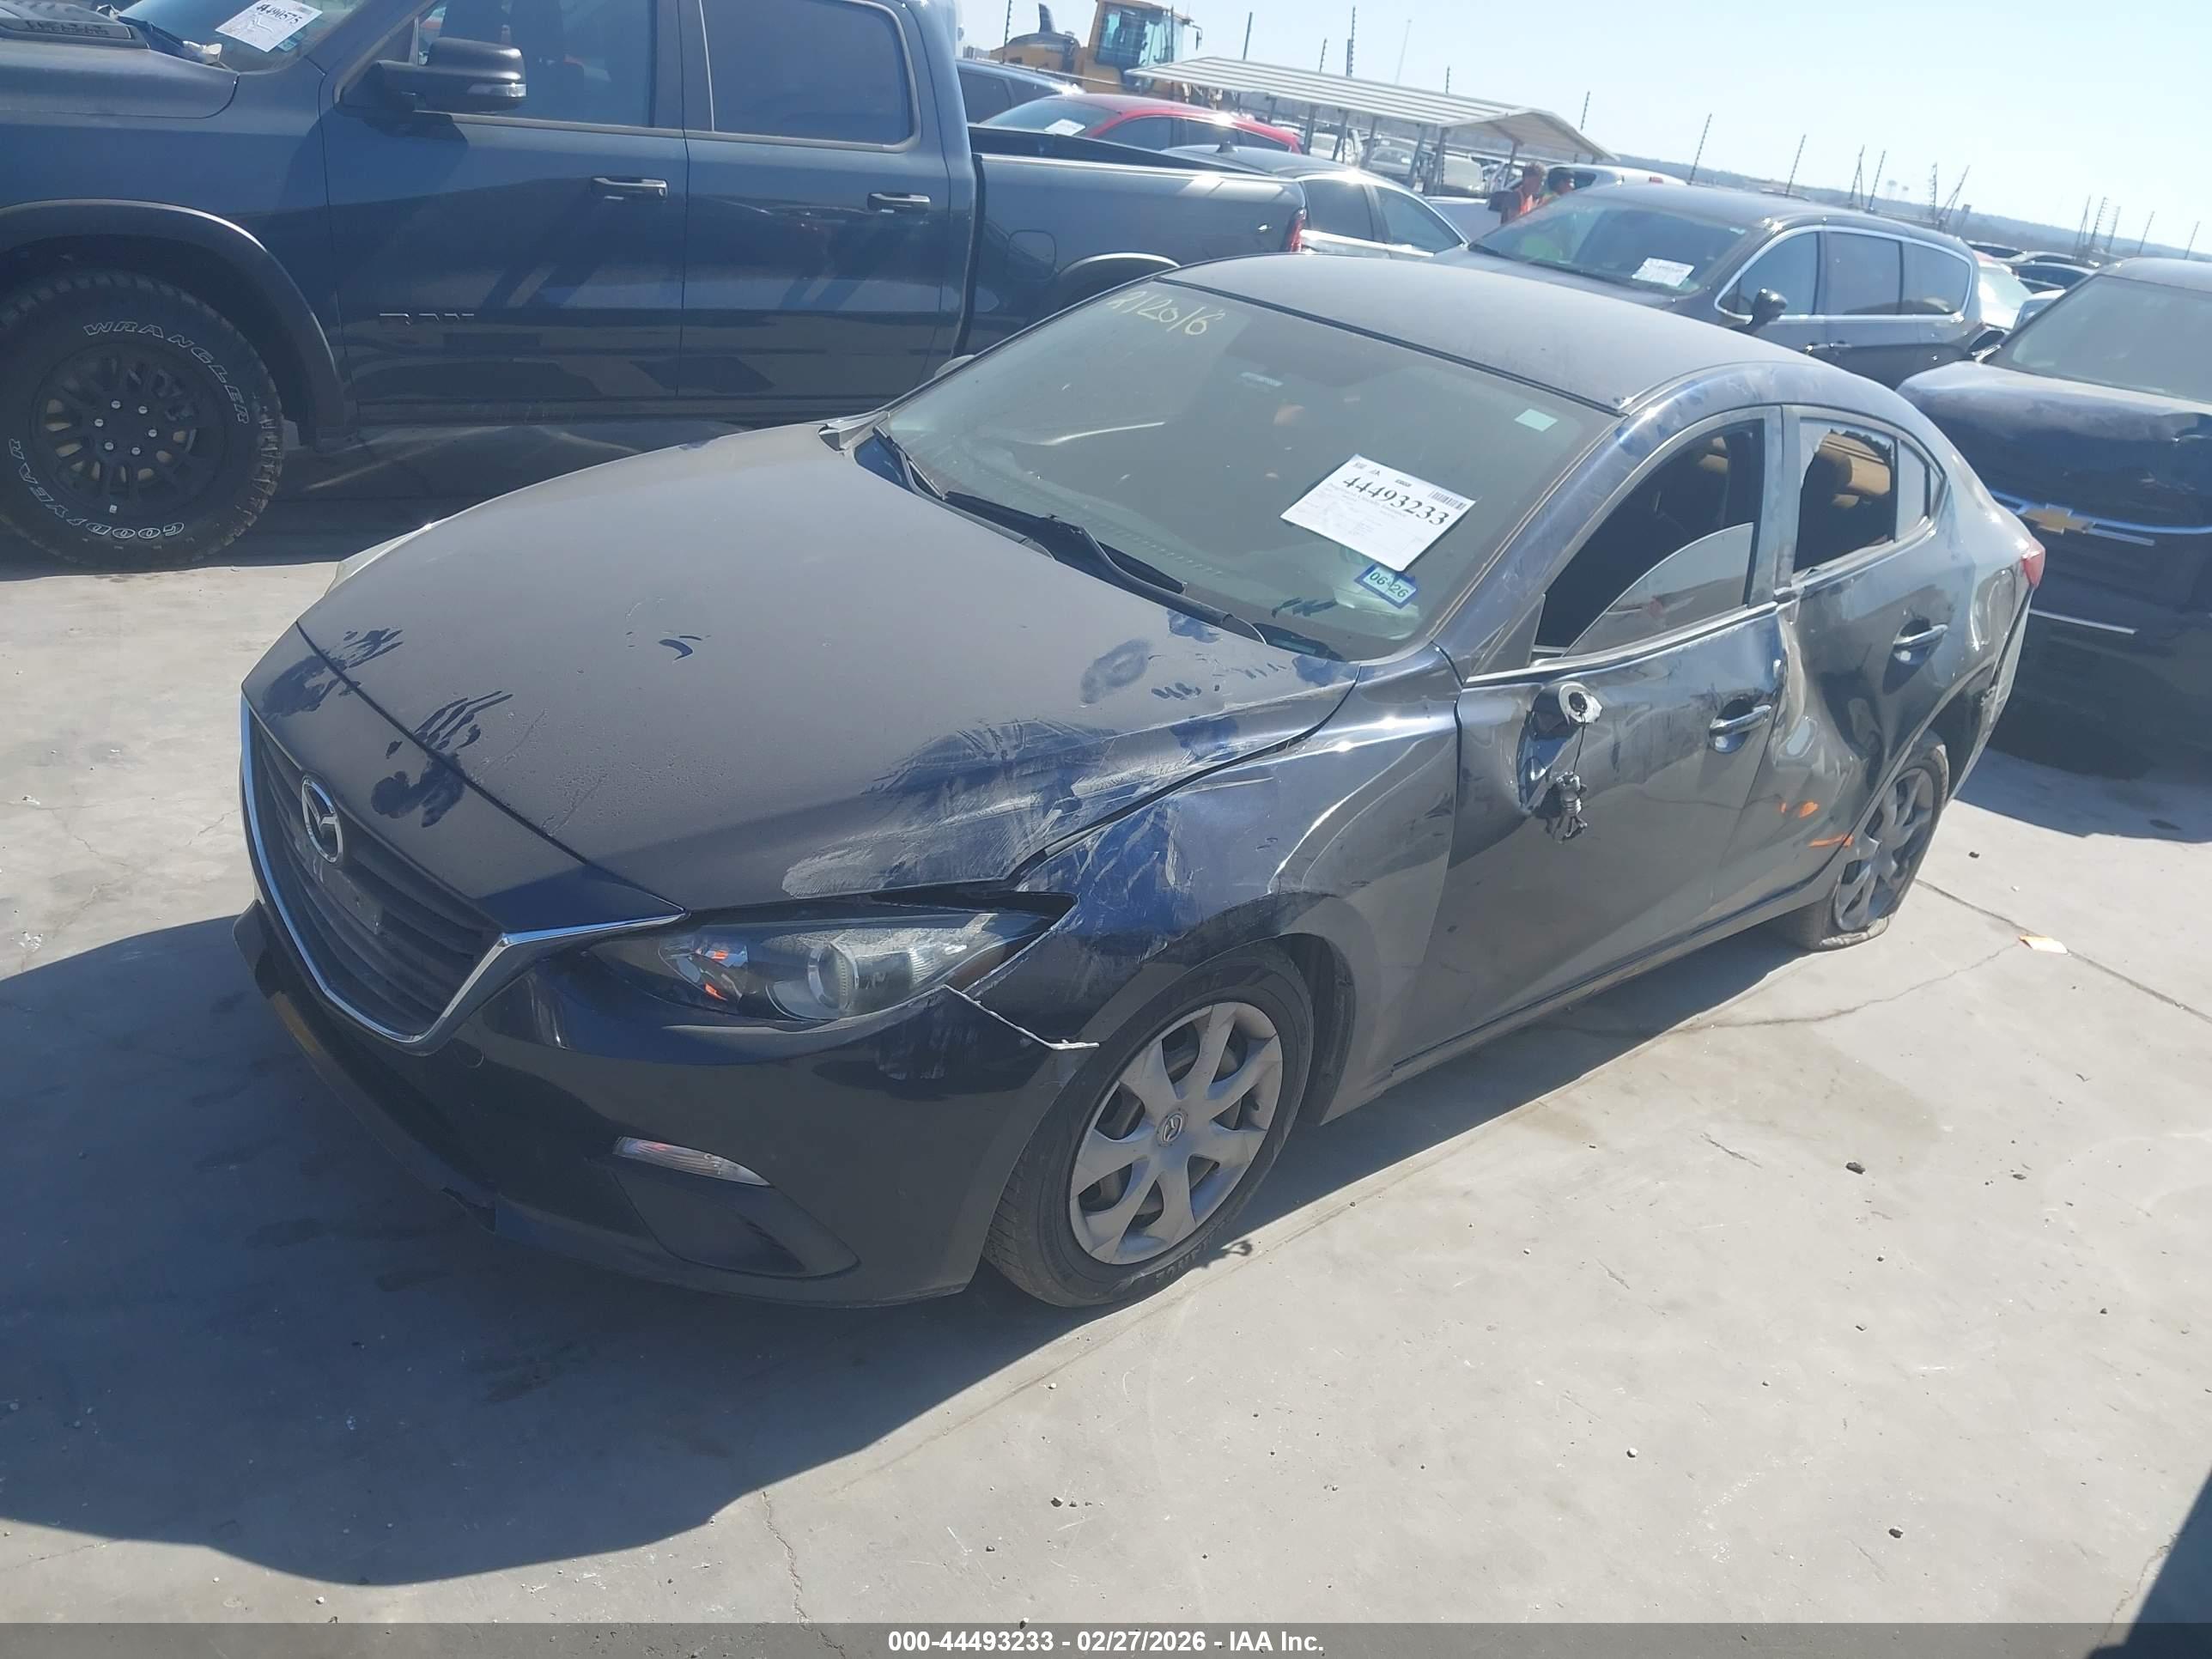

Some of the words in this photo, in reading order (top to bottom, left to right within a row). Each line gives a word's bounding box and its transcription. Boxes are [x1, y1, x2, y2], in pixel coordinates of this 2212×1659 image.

[83, 321, 249, 424] WRANGLER
[8, 438, 185, 539] GOODYEAR
[1342, 476, 1450, 526] 44493233
